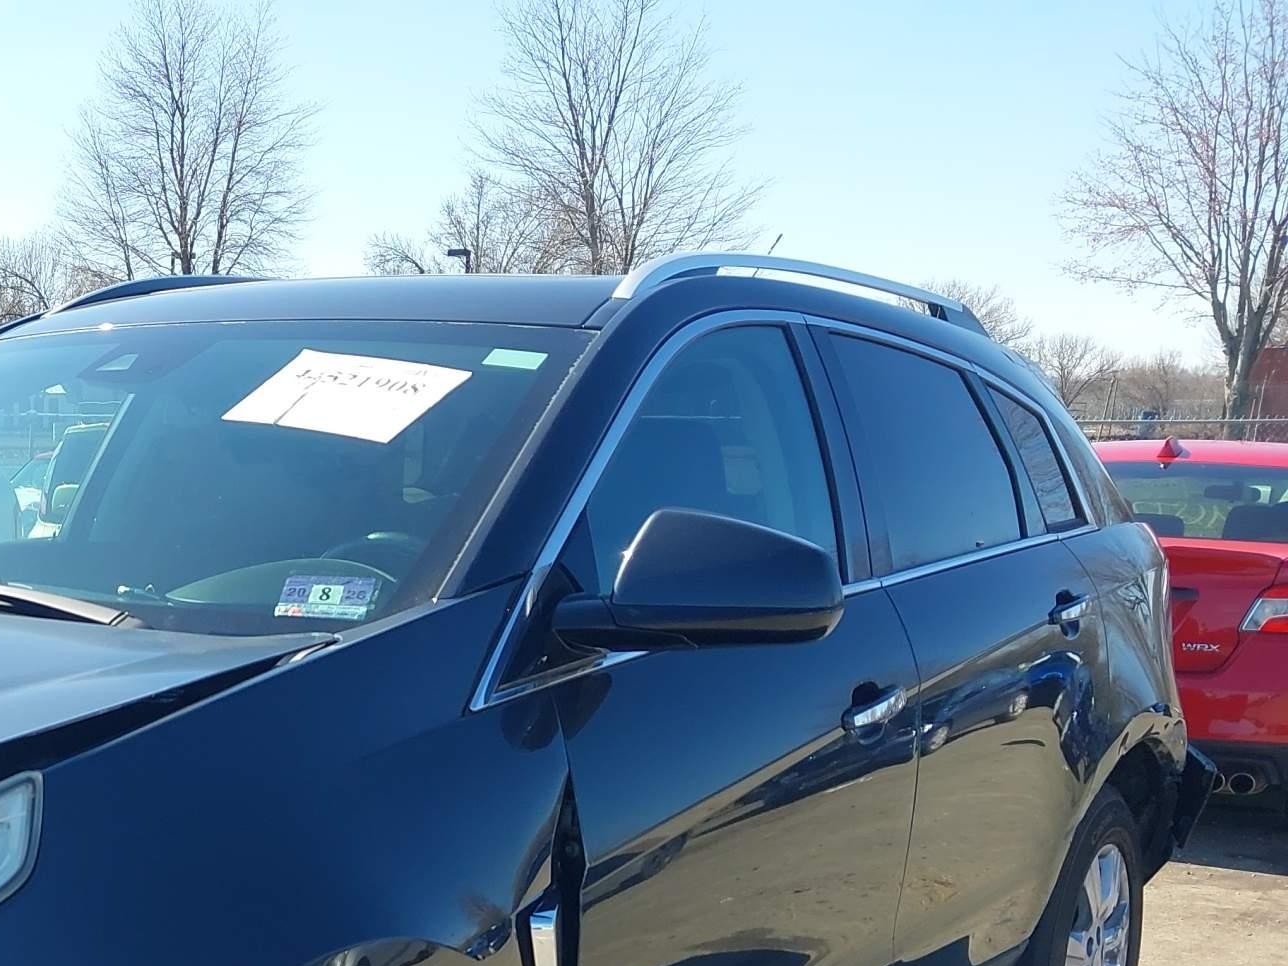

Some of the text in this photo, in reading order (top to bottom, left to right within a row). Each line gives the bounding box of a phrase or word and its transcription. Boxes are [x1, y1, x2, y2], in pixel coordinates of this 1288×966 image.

[287, 586, 307, 598] 20
[318, 586, 332, 601] 8
[1182, 642, 1221, 652] WRX
